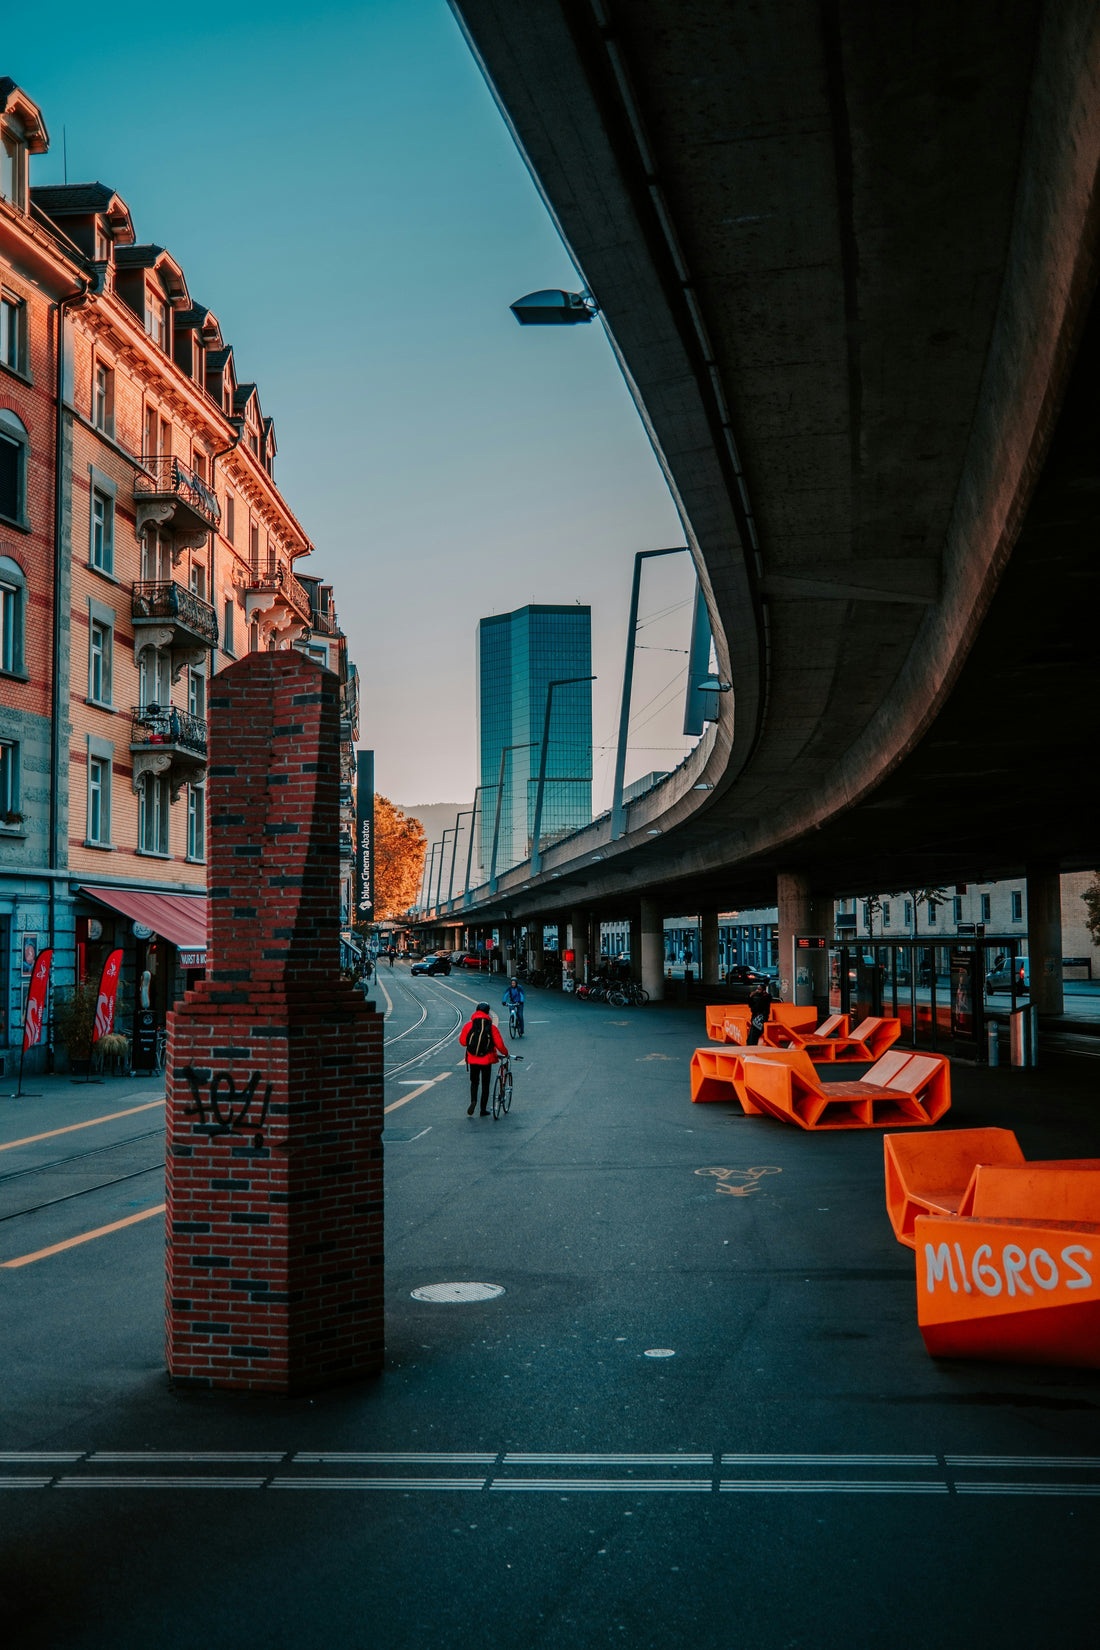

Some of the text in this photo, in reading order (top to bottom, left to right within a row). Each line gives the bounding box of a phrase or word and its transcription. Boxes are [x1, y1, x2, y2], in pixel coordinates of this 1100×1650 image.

[361, 819, 370, 899] blue Cinema Abaton
[924, 1242, 1093, 1297] MIGROS
